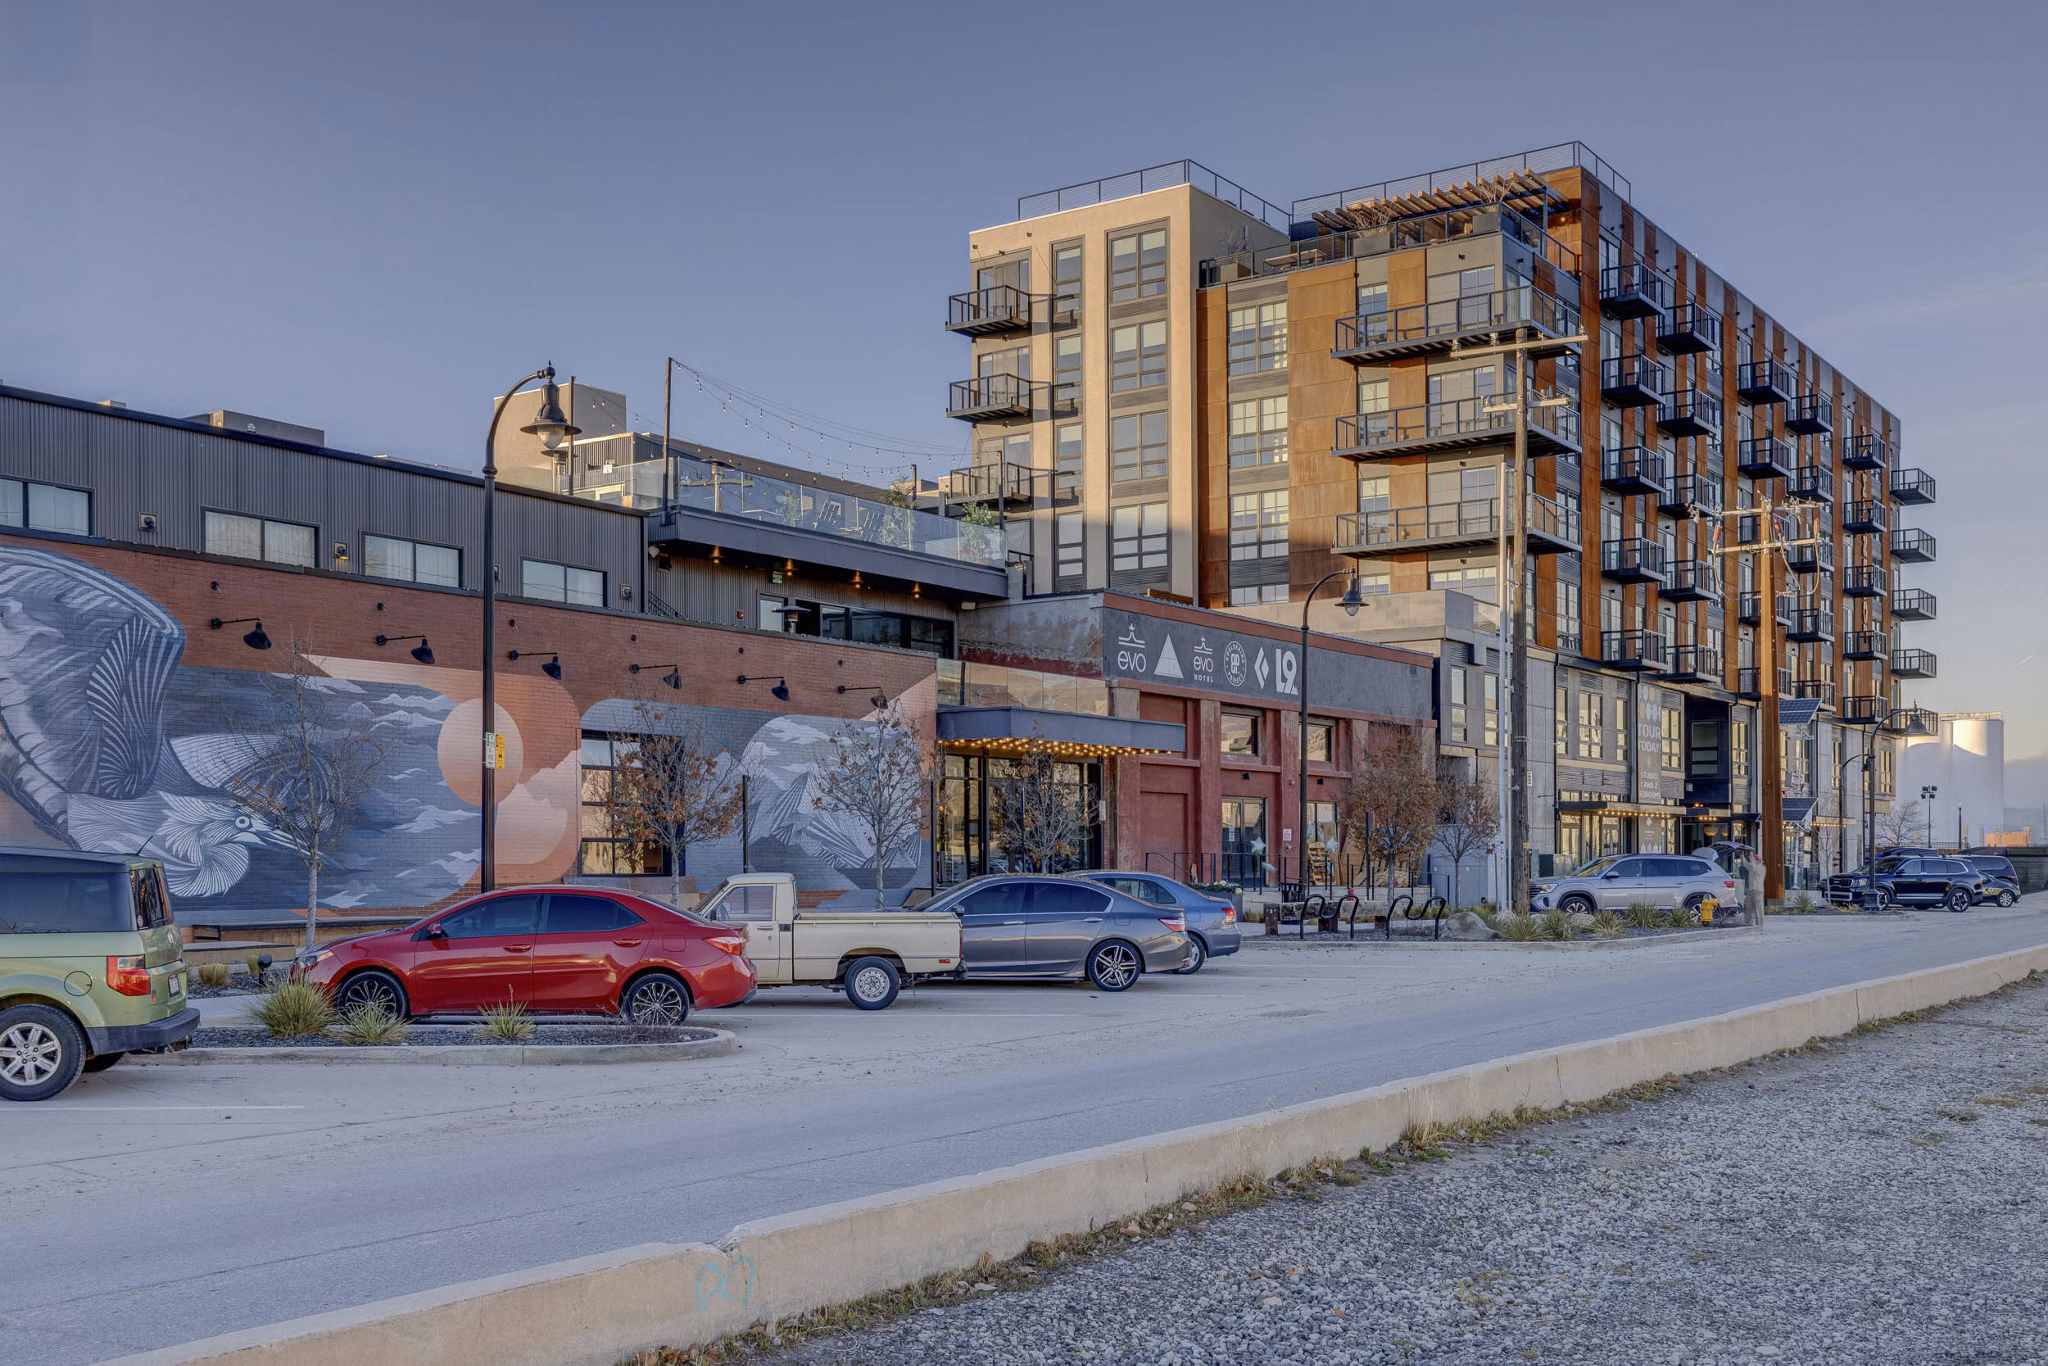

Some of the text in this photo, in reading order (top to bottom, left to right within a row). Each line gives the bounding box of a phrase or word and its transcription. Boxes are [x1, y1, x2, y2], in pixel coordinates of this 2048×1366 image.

[1118, 650, 1147, 673] evo
[1193, 656, 1213, 672] evo
[1193, 674, 1213, 683] HOTEL
[1638, 723, 1661, 740] TOUR
[1654, 781, 1658, 790] 2
